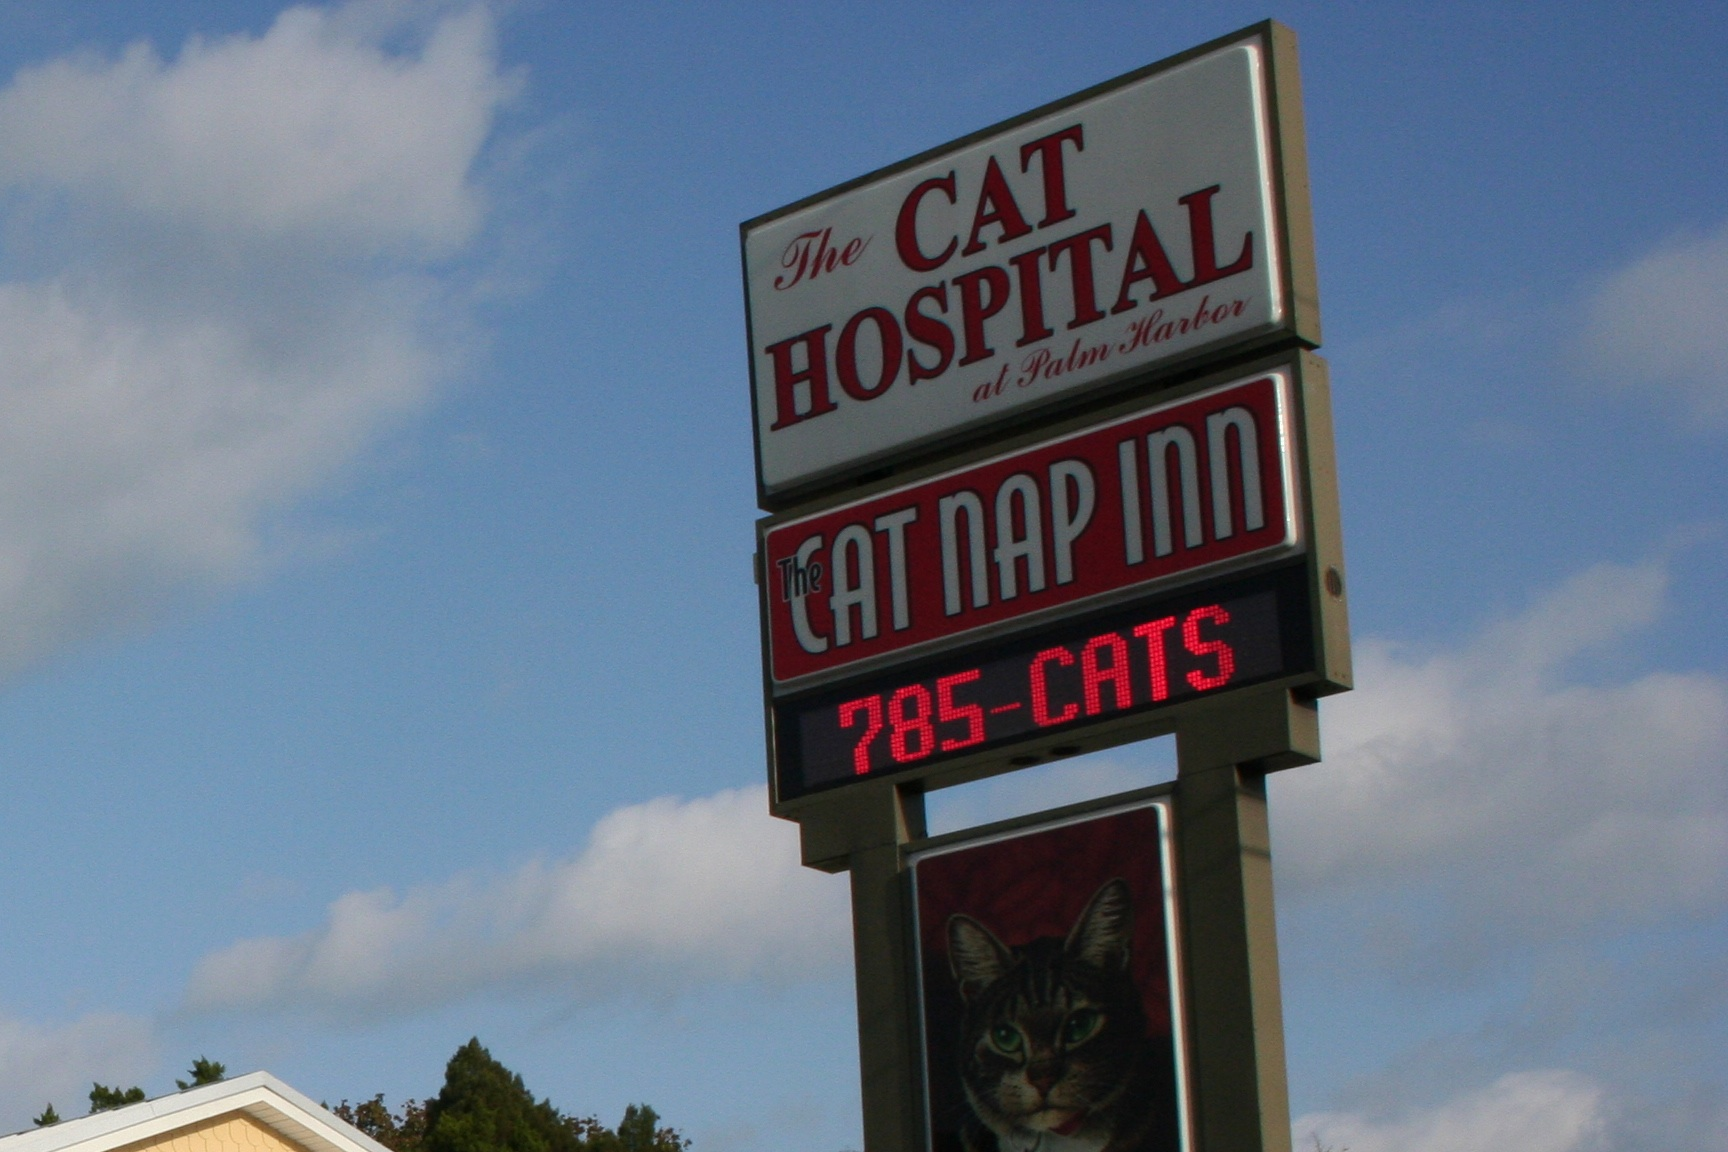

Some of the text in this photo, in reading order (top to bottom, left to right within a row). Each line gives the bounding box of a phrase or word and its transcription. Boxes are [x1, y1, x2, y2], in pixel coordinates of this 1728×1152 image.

[773, 122, 1084, 291] The CAT
[765, 184, 1254, 433] HOSPITAL
[973, 295, 1252, 402] at Palm Harbor
[776, 554, 823, 602] The
[790, 405, 1265, 653] CAT NAP INN
[838, 603, 1235, 776] 785-CATS
